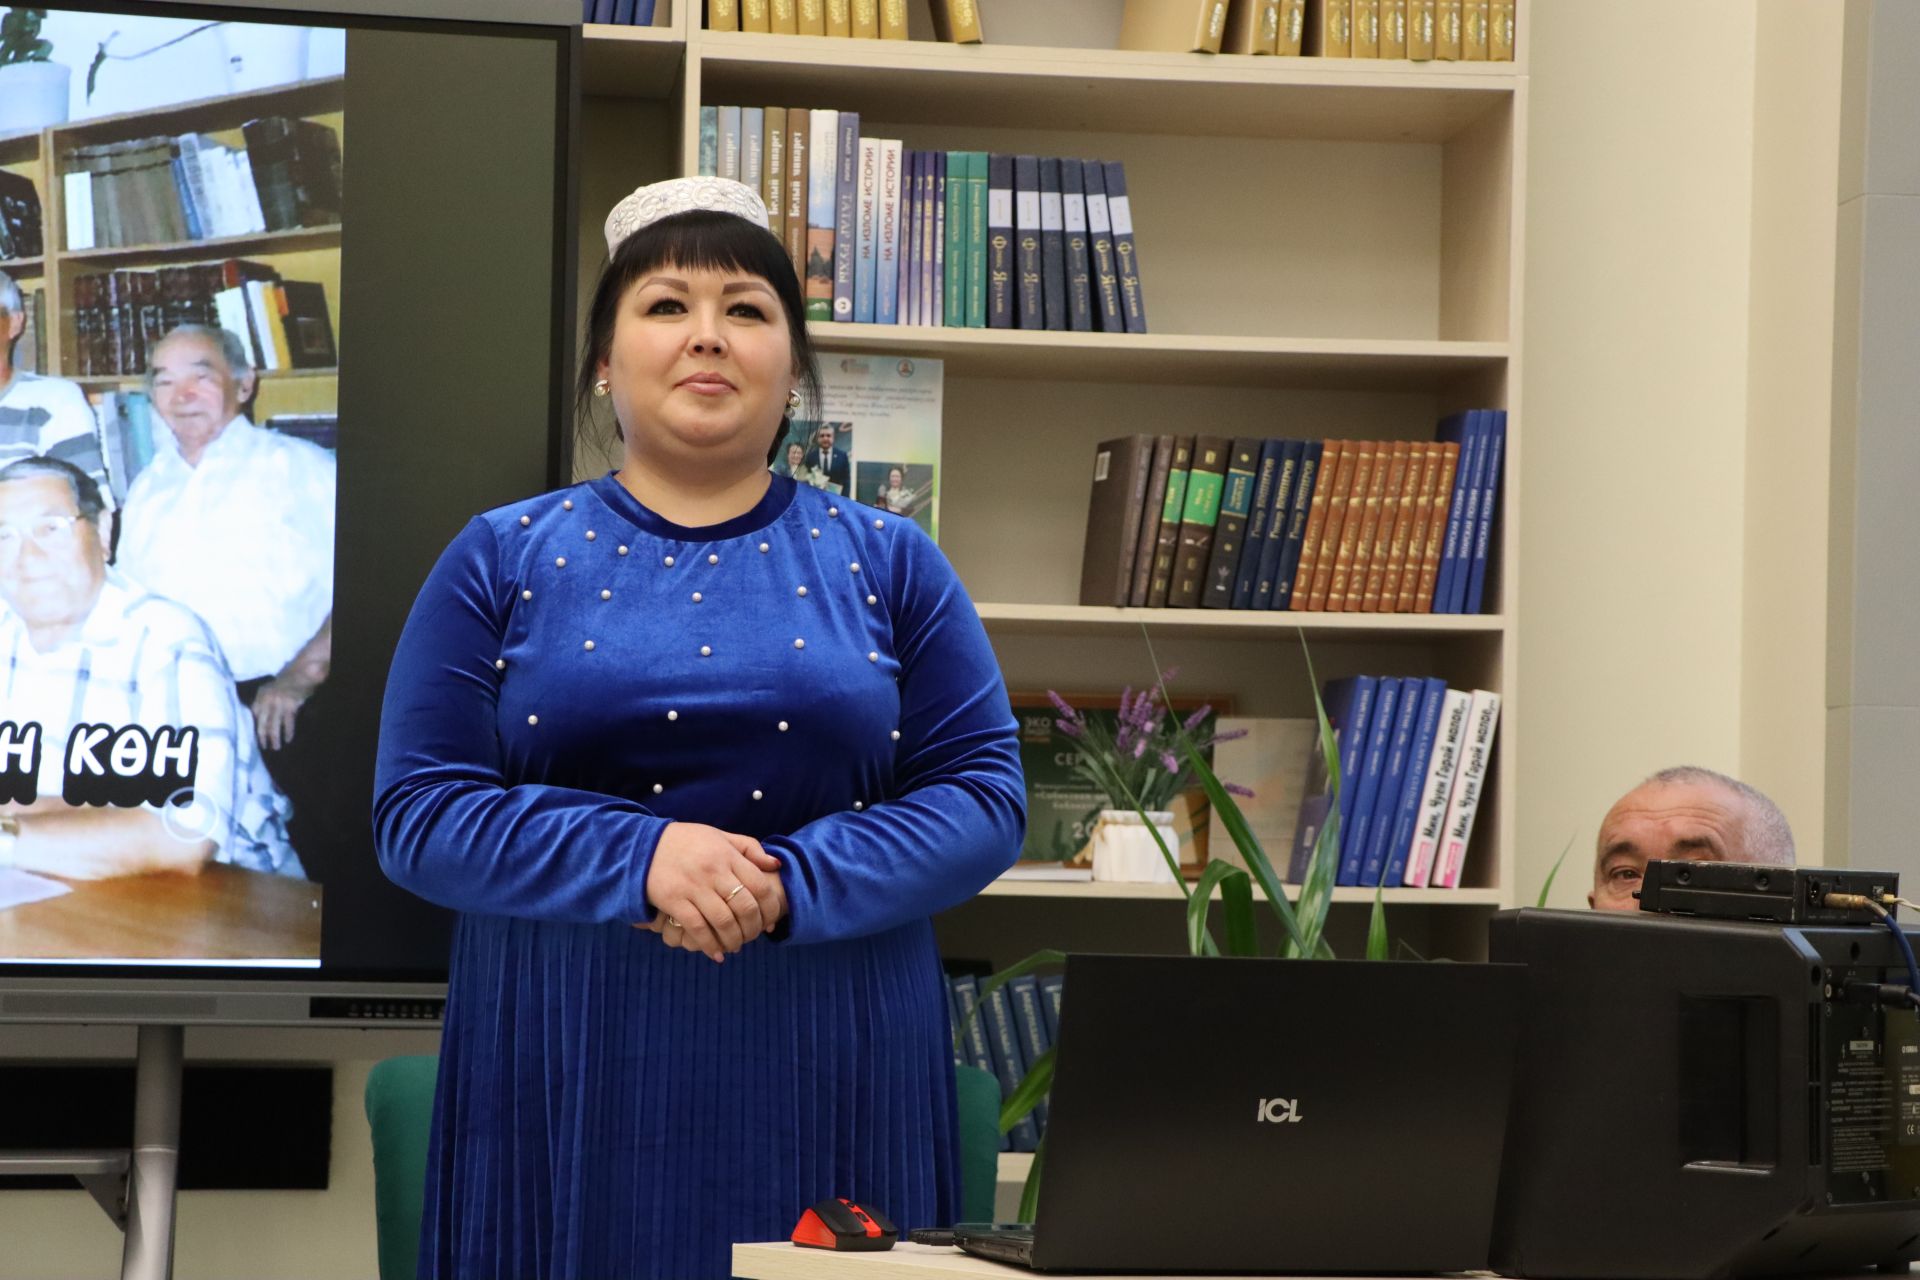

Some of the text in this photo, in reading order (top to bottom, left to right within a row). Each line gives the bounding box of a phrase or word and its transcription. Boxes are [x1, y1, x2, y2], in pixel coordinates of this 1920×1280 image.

[863, 146, 875, 197] ИСТОРИИ
[885, 148, 896, 199] ИСТОРИИ
[841, 193, 852, 238] ТАТАР
[862, 199, 873, 242] ИЗЛОМЕ
[884, 201, 894, 244] ИЗЛОМЕ
[862, 244, 872, 259] НА
[883, 246, 893, 261] НА
[67, 724, 197, 780] КӨН
[1257, 1097, 1303, 1123] ICL
